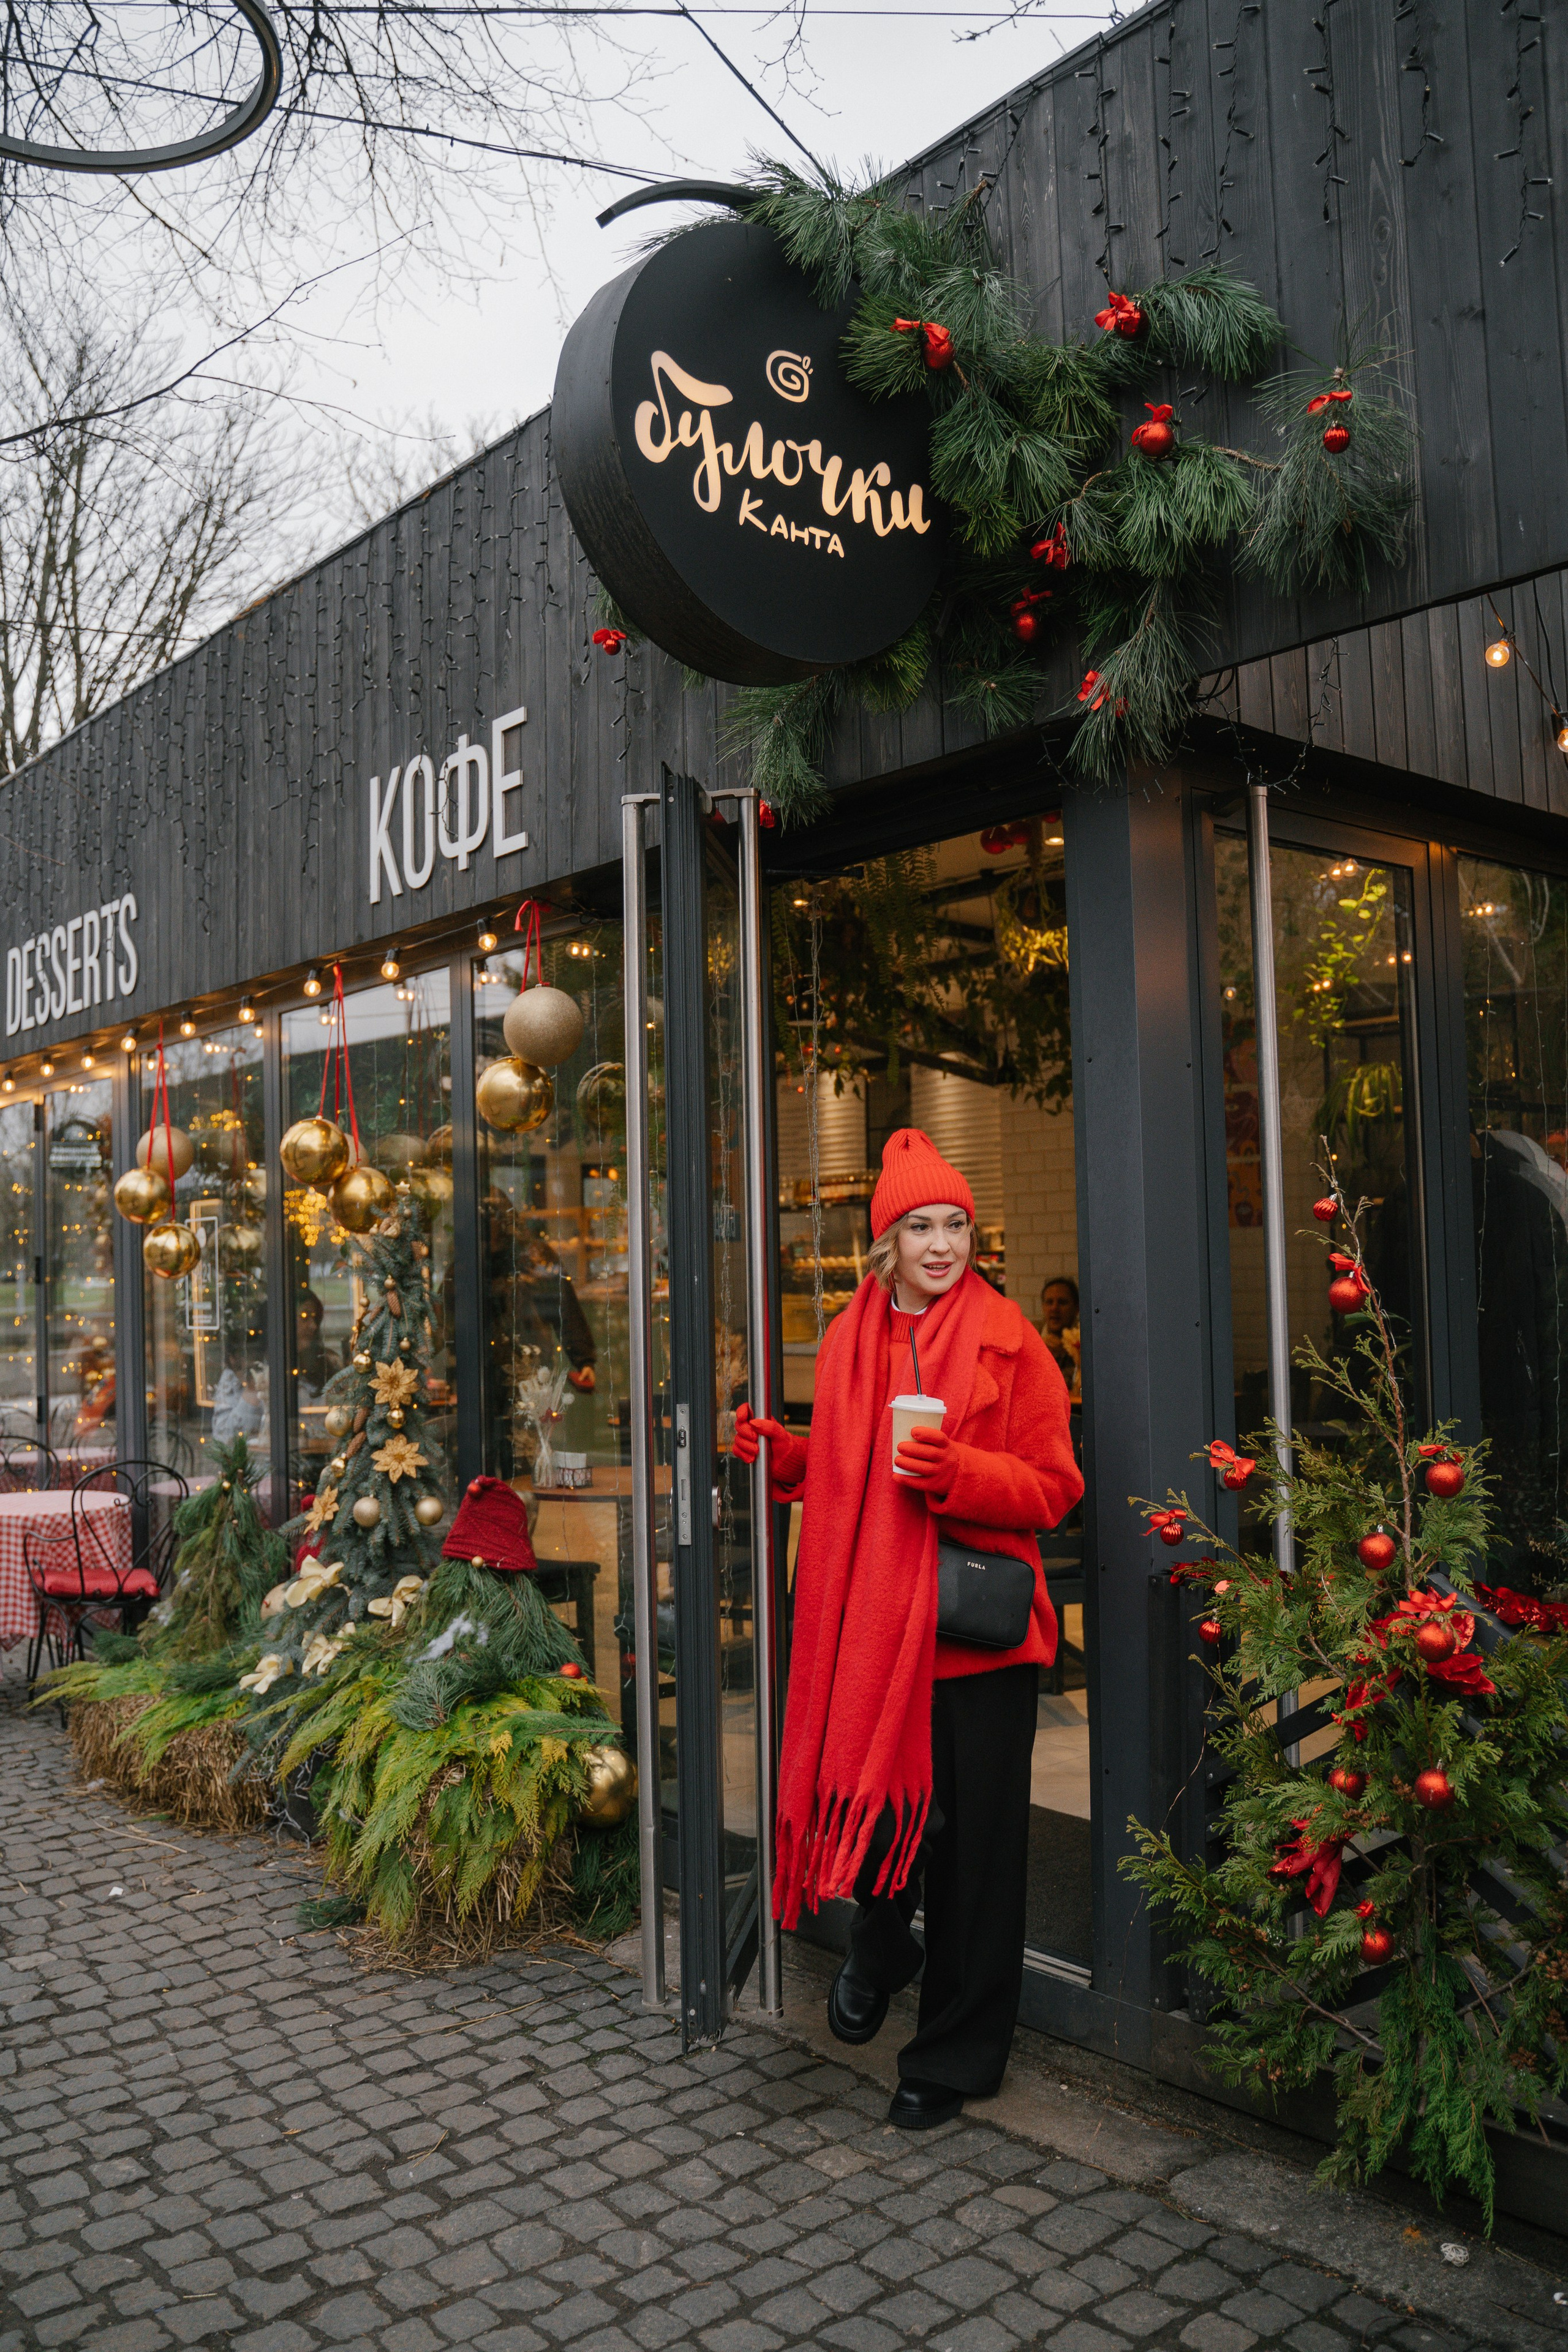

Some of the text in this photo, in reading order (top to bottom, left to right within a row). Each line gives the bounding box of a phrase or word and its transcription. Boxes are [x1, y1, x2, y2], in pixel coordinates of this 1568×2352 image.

[739, 488, 845, 558] КАНТА
[369, 706, 529, 905] КОФЕ
[6, 893, 137, 1036] DESSERTS
[967, 1561, 986, 1570] FURLA
